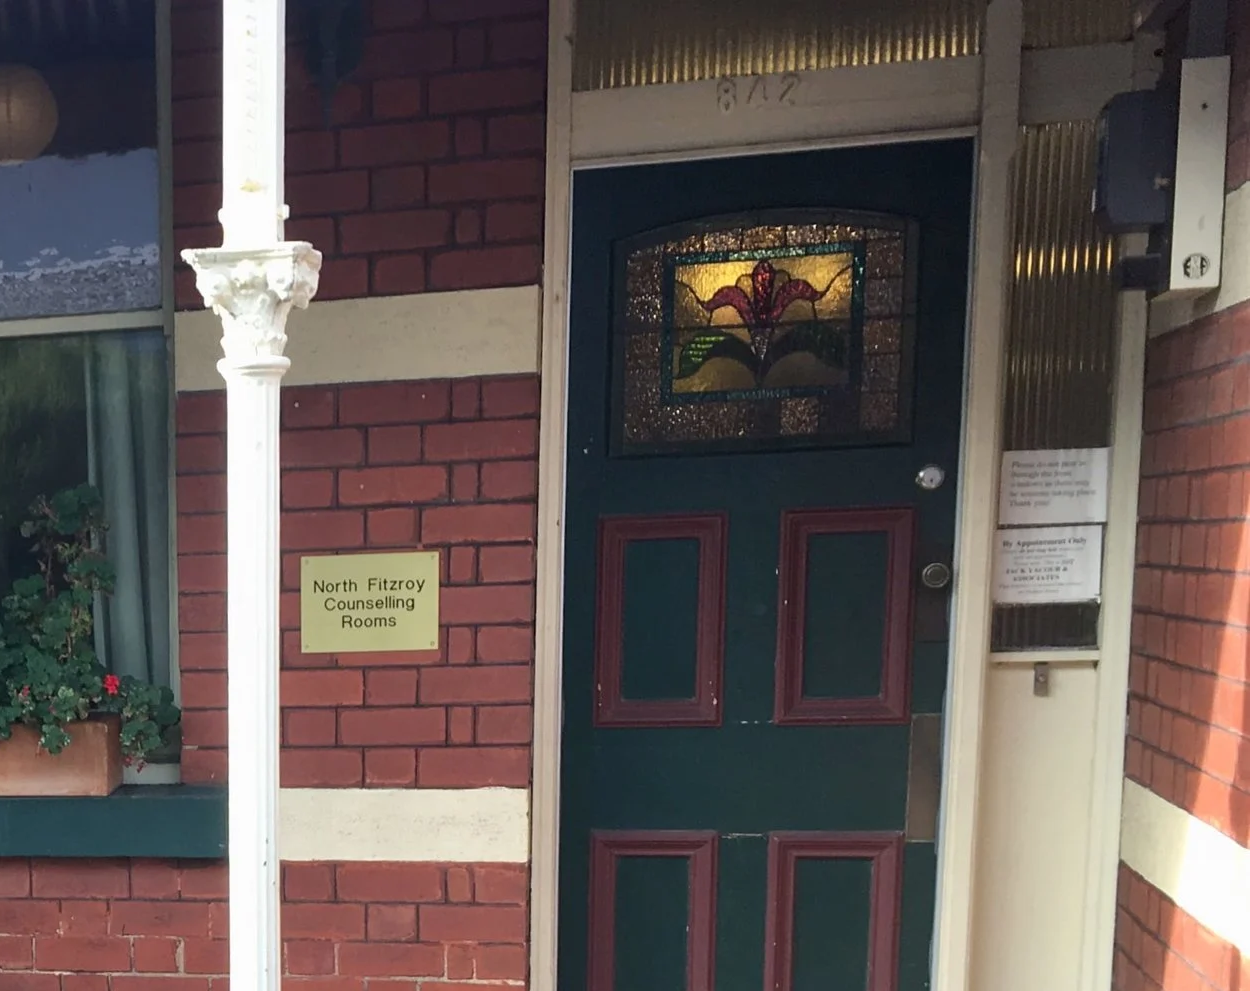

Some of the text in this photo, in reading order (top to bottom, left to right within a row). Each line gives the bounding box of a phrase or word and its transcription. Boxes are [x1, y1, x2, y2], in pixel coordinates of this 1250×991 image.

[313, 578, 426, 593] North Fitzroy
[324, 596, 415, 611] Counselling
[341, 615, 397, 628] Rooms
